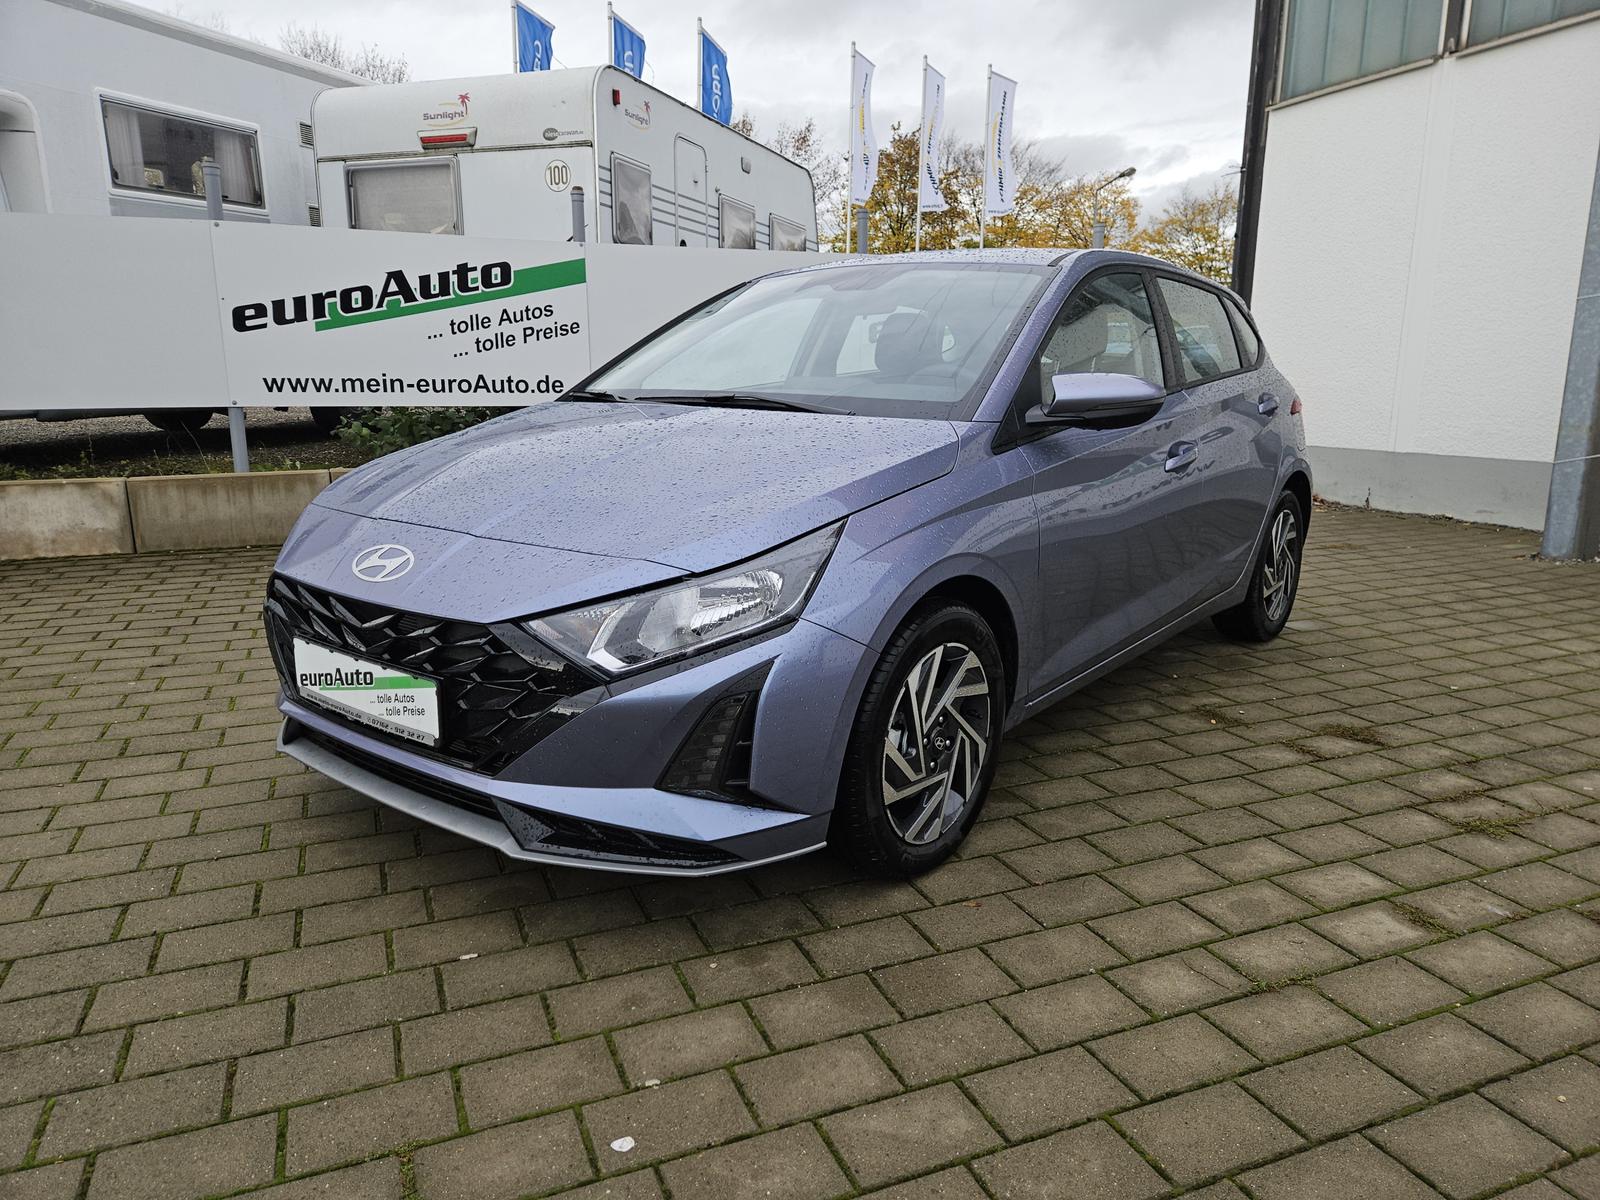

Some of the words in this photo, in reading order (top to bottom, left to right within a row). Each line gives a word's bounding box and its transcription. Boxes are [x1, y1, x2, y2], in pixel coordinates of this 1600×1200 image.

[423, 111, 464, 121] Sunlight
[625, 108, 649, 126] Sunlight
[548, 165, 568, 185] 100
[231, 261, 512, 333] euroAuto
[450, 313, 492, 336] tolle
[498, 303, 555, 327] Autos
[475, 331, 516, 354] tolle
[523, 319, 581, 345] Preise
[262, 373, 564, 395] www.mein-euroAuto.de
[300, 668, 374, 687] euroAuto
[377, 694, 392, 704] tolle
[393, 693, 415, 704] Autos
[386, 707, 401, 717] tolle
[402, 705, 426, 717] Preise
